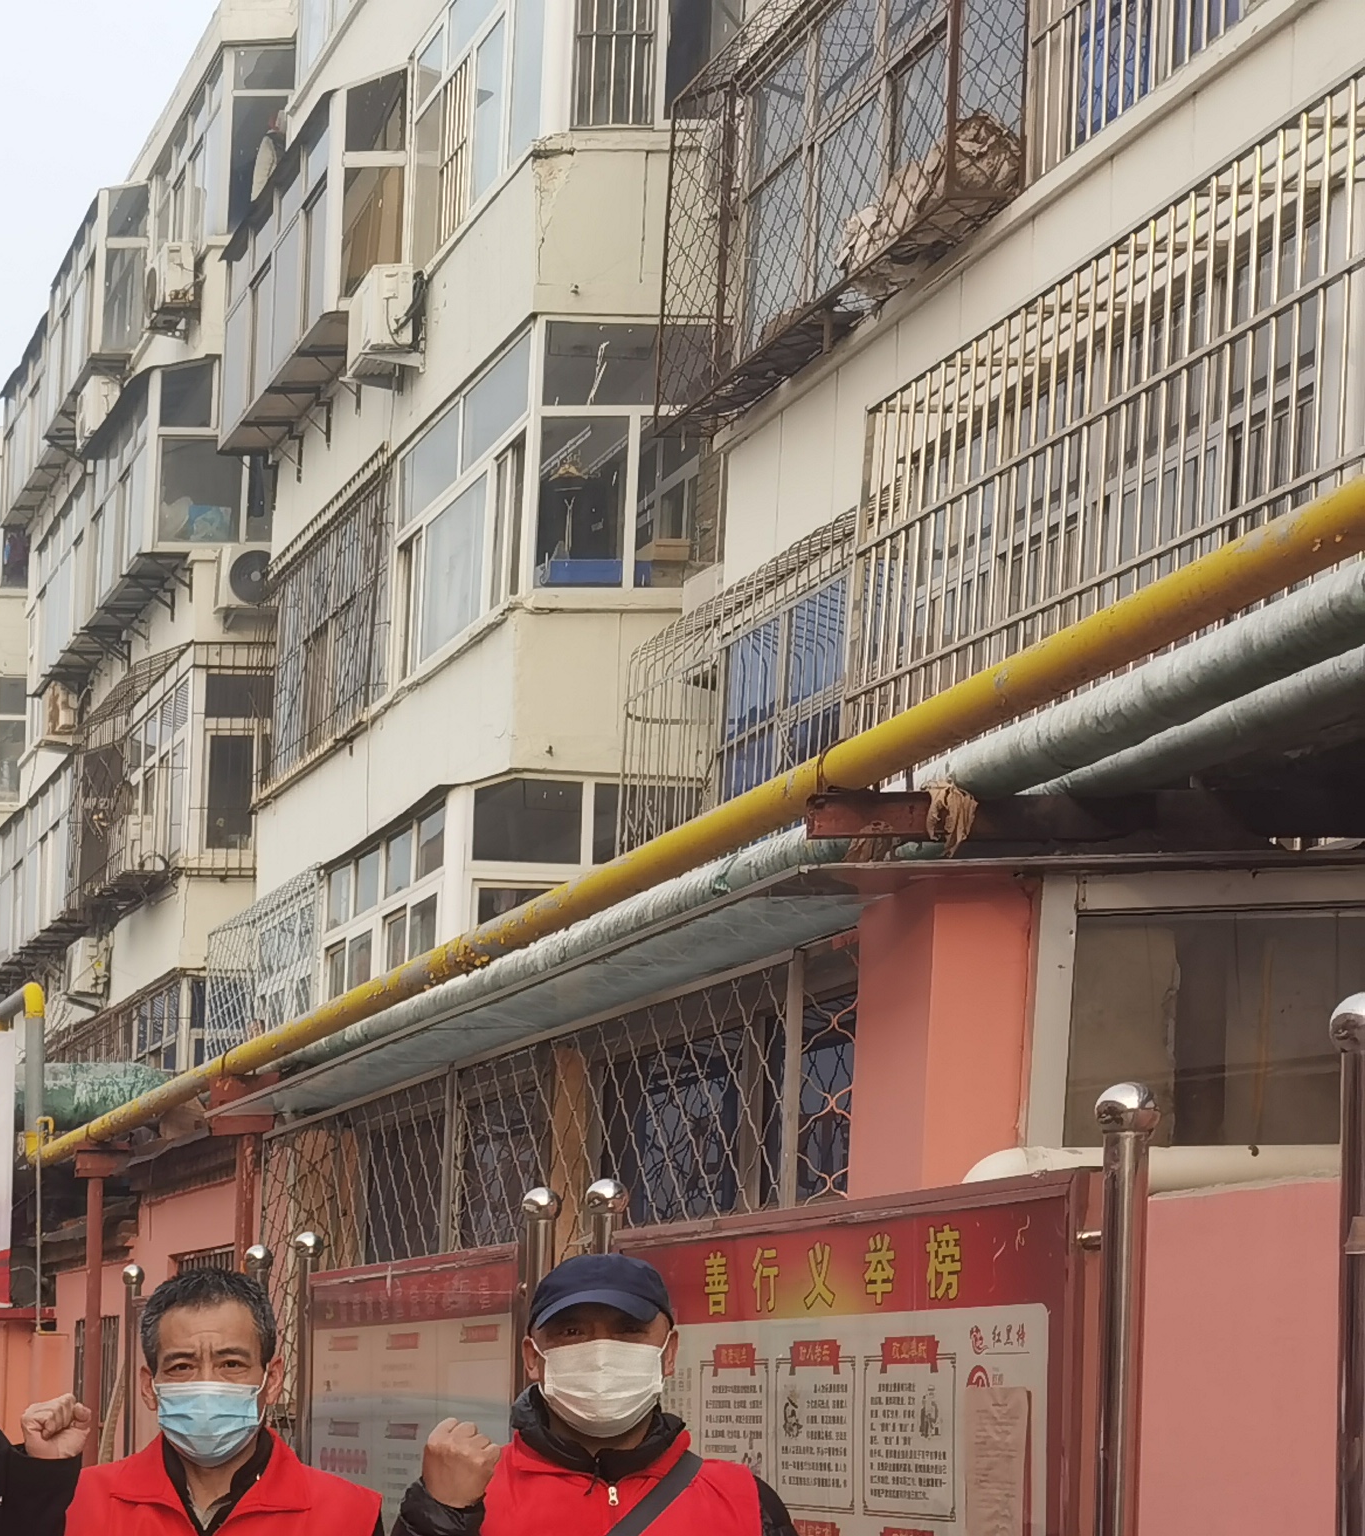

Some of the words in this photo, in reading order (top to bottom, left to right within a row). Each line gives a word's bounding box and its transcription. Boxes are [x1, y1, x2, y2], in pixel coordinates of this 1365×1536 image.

[703, 1223, 962, 1316] 善行义举榜
